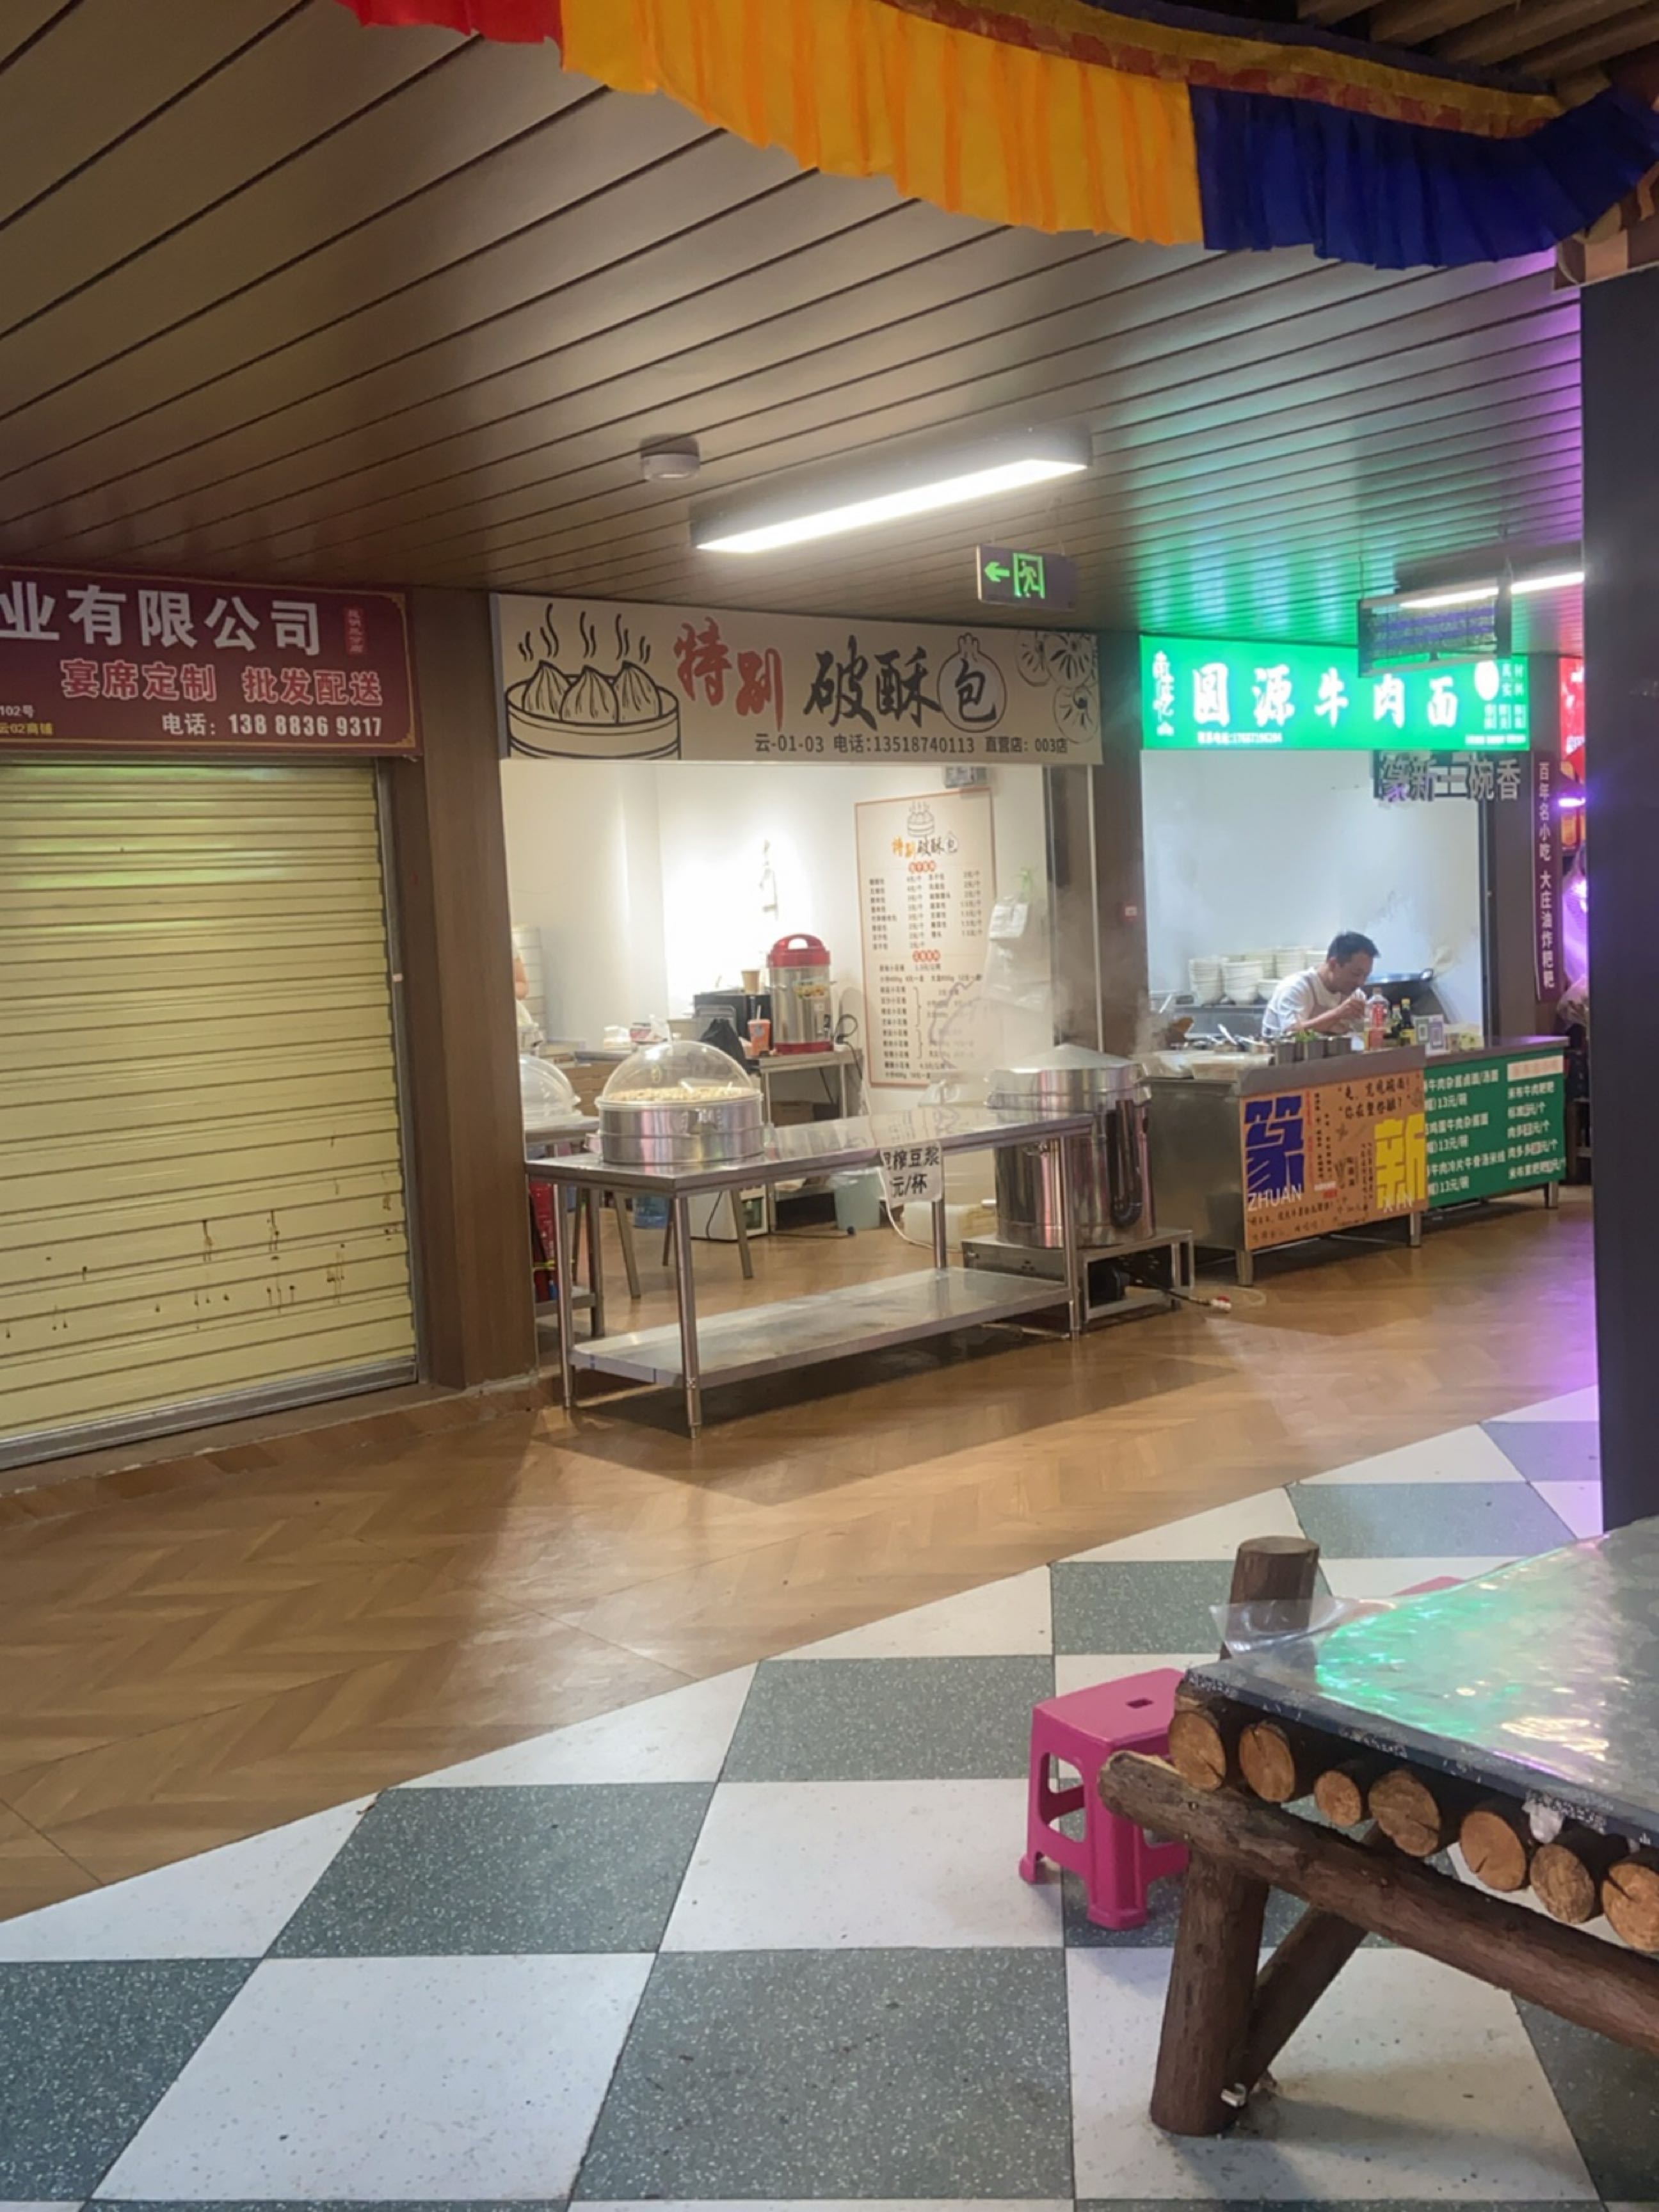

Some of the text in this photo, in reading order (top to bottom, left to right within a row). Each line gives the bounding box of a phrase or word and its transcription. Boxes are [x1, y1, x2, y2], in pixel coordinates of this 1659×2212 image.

[0, 582, 320, 655] 业有限公司
[60, 658, 383, 706] 宴席定制 批发配送
[674, 617, 997, 732] 特别 破酥包
[228, 714, 267, 734] 138
[275, 715, 328, 736] 8836
[337, 717, 381, 736] 9317
[755, 733, 824, 753] 云-01-03
[1244, 1096, 1304, 1196] 篆
[1375, 1112, 1425, 1208] 新
[1249, 1184, 1302, 1211] ZHUAN
[1384, 1192, 1414, 1213] XIN
